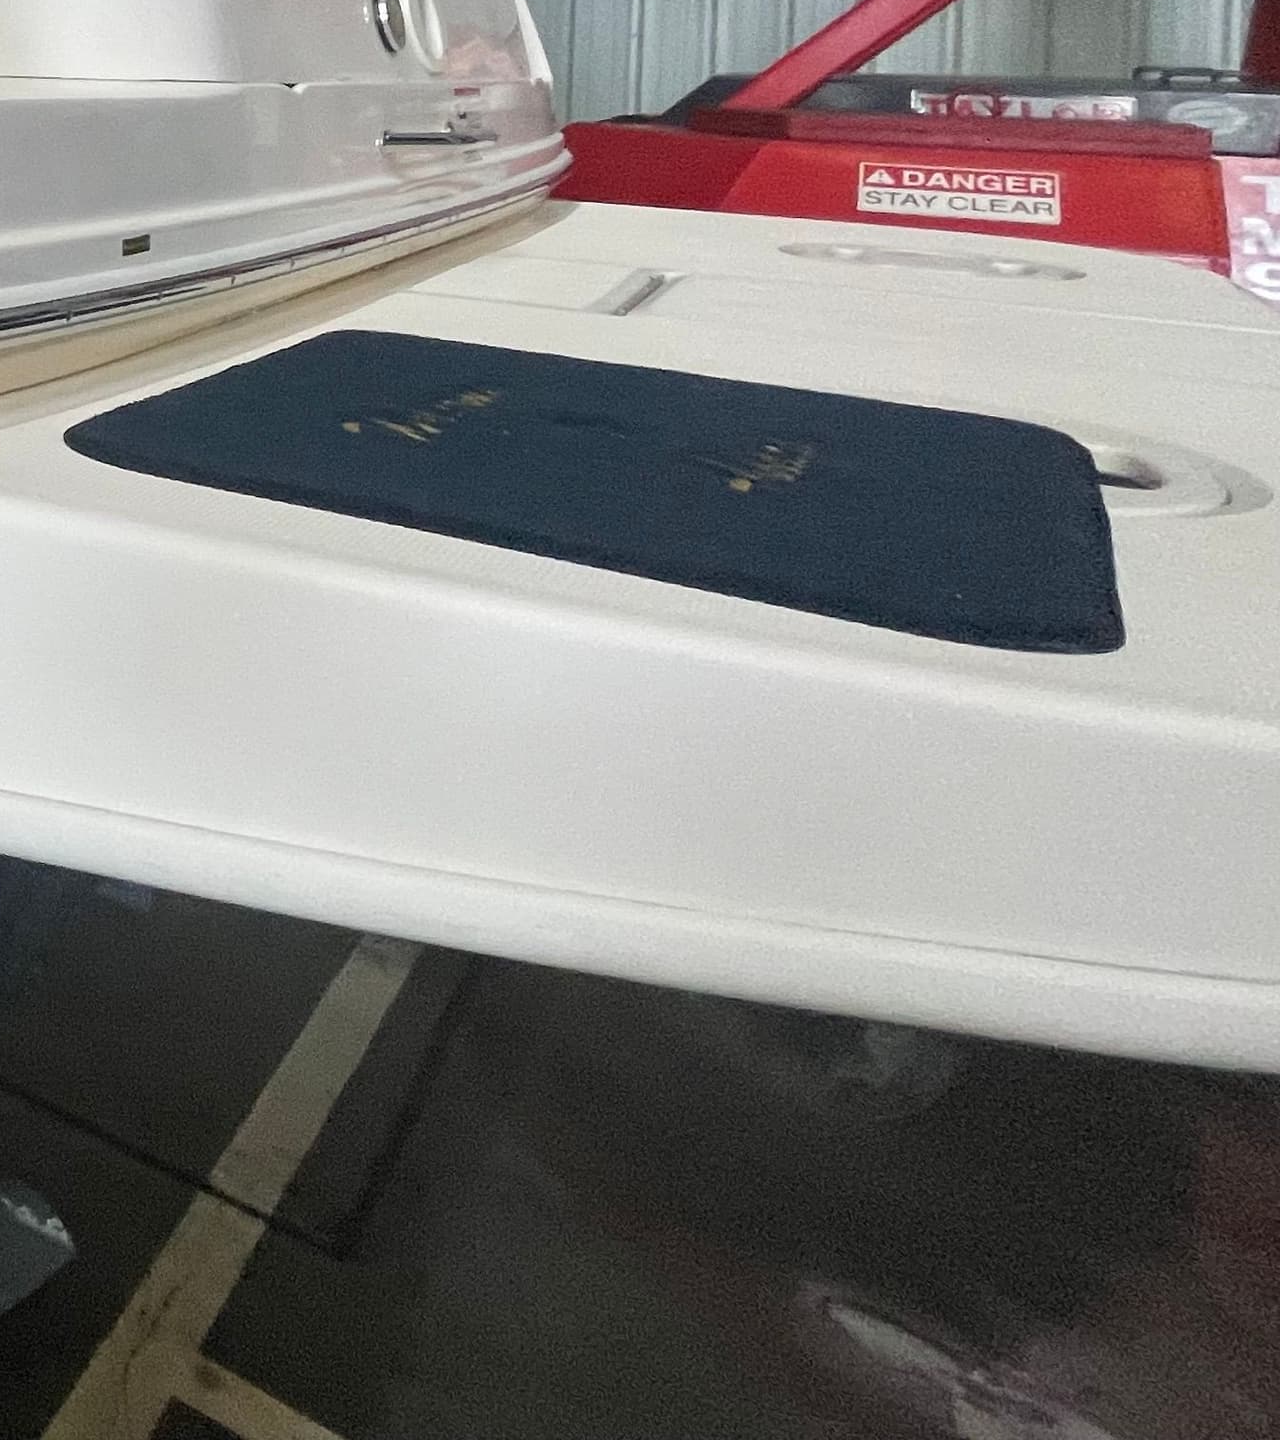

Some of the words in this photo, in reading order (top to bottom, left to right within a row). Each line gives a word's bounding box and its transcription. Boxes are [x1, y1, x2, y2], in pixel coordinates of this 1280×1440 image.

[902, 170, 1054, 196] DANGER
[865, 190, 938, 209] STAY
[947, 196, 1054, 217] CLEAR
